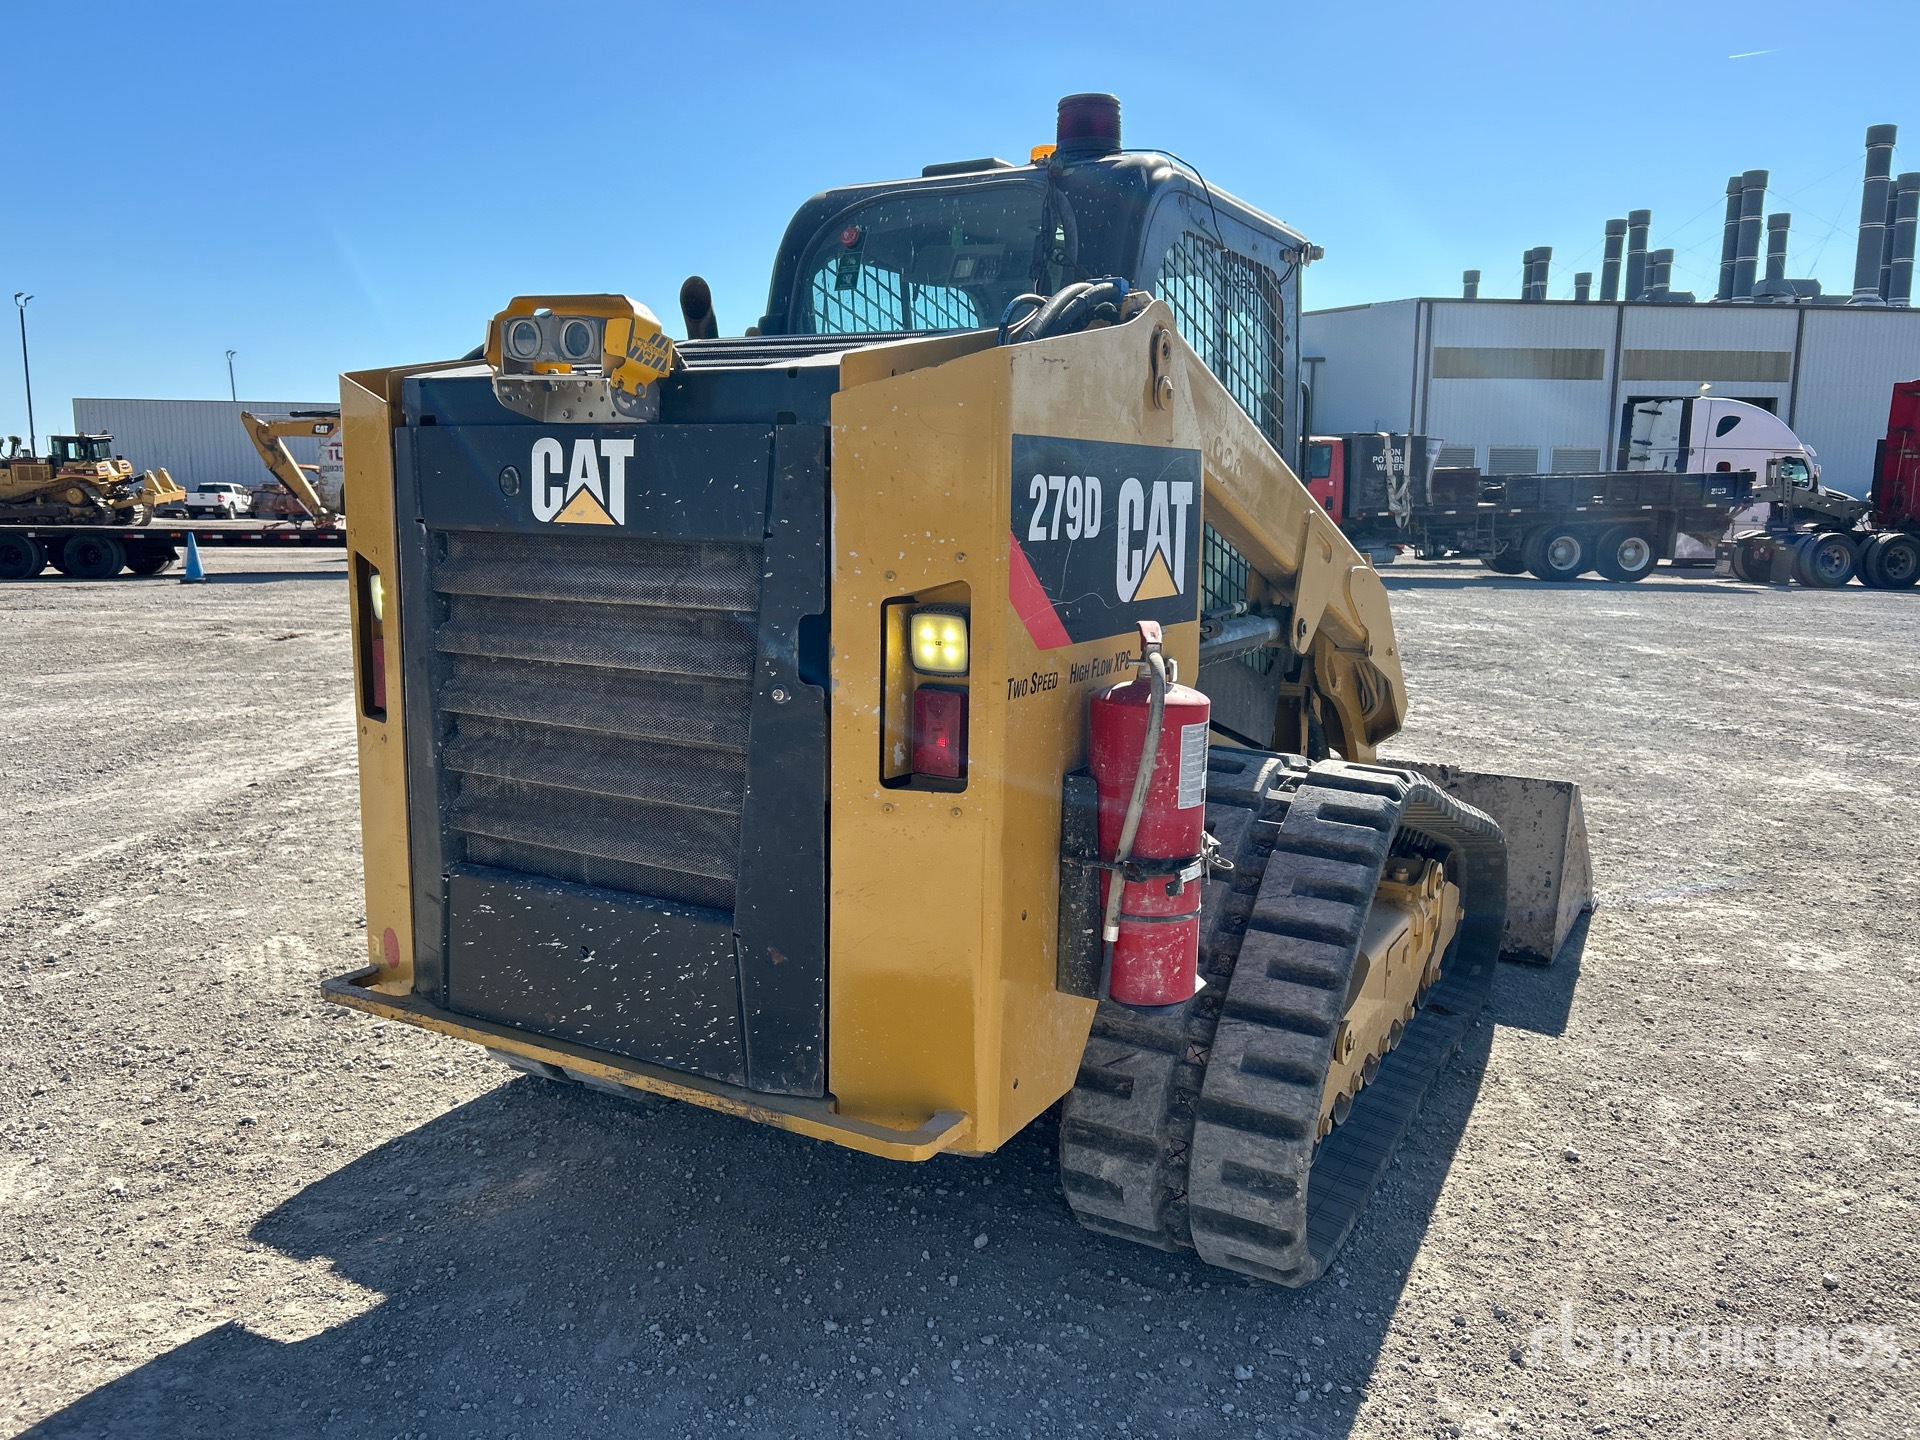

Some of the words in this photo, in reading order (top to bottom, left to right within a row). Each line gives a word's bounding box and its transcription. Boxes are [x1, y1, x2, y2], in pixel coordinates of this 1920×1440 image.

[315, 425, 329, 433] CAT
[1372, 456, 1405, 464] POABL
[1375, 463, 1404, 472] WAER
[531, 437, 635, 526] CAT
[1027, 473, 1103, 542] 279D
[1115, 477, 1193, 603] CAT
